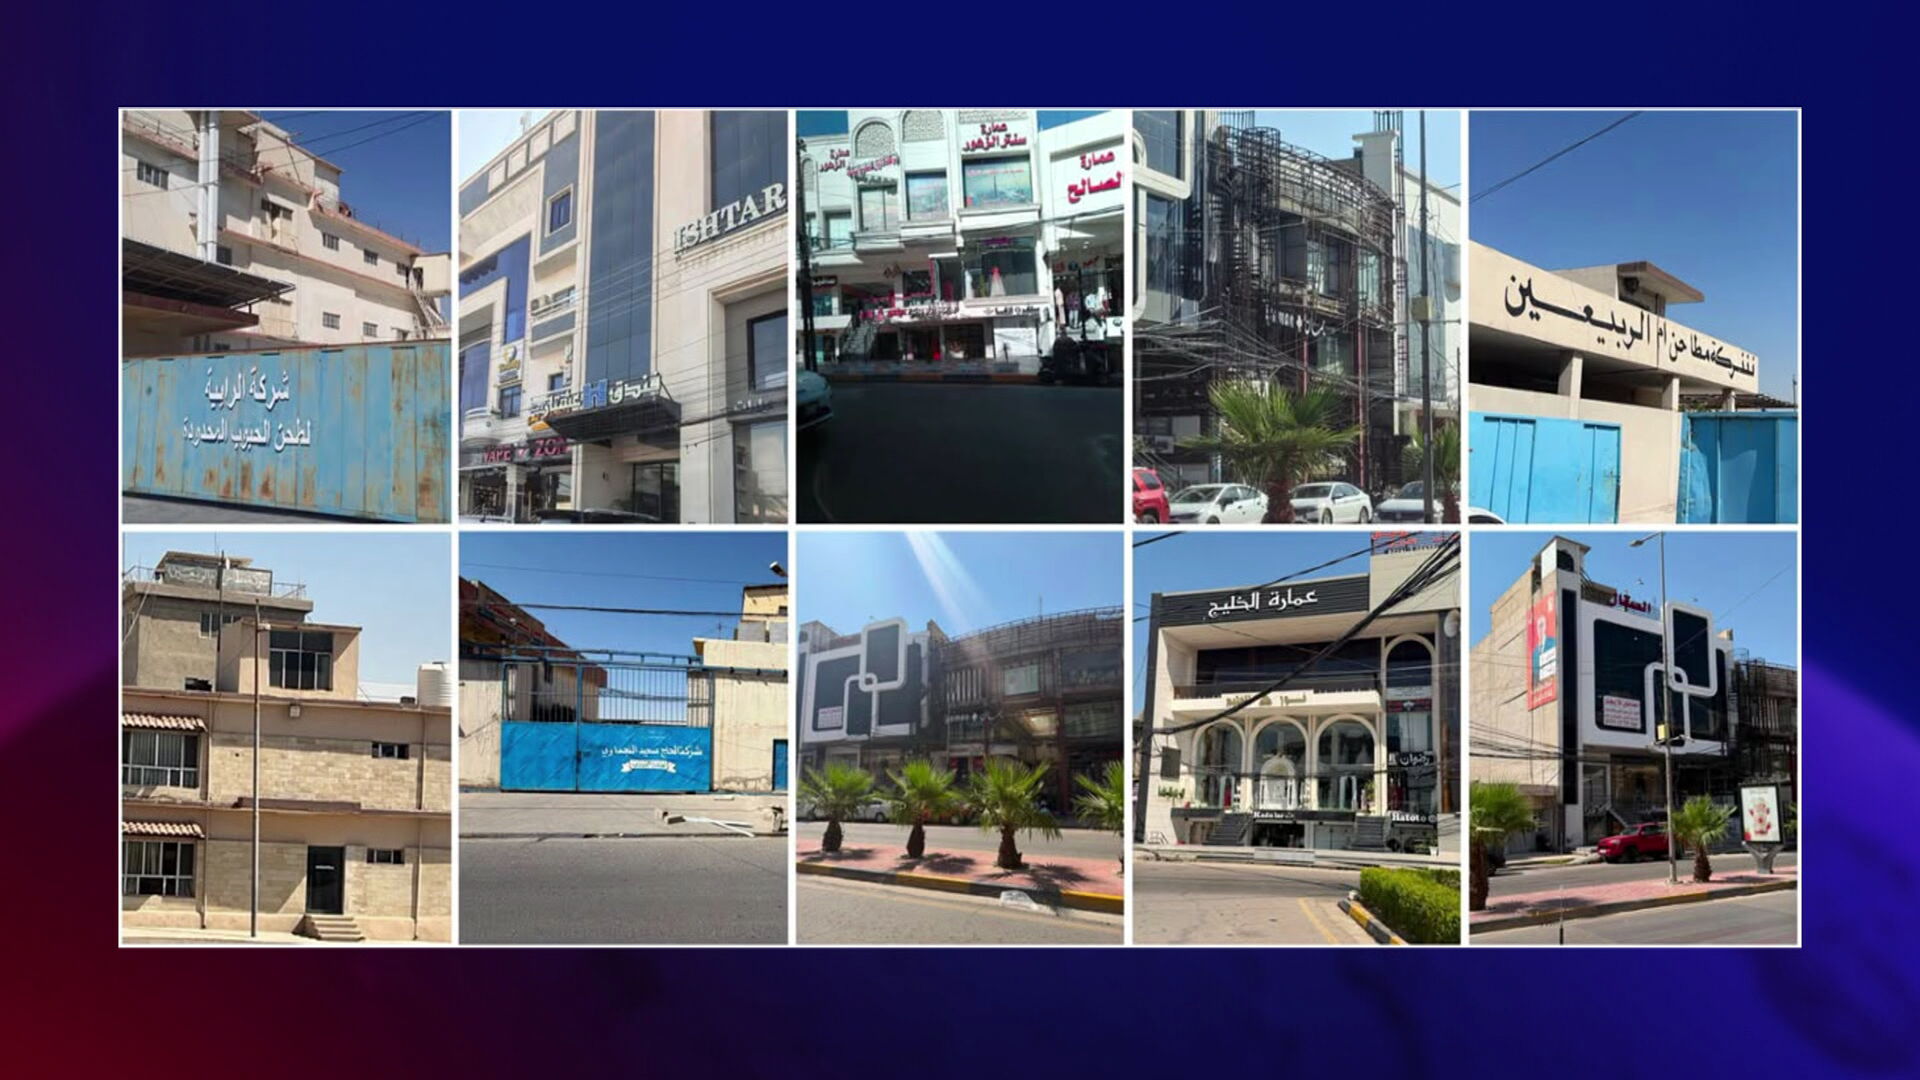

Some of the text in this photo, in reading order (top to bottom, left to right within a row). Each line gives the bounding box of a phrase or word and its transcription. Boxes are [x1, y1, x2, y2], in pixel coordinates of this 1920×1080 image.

[962, 135, 1000, 152] الزهور
[980, 121, 1008, 136] عمارة
[1080, 150, 1115, 170] عمارة
[1067, 171, 1124, 204] لصالح
[674, 182, 787, 254] ISHTAR
[1504, 275, 1651, 350] الربيعين
[204, 366, 290, 412] شركة الرابية
[609, 373, 661, 404] فندق
[182, 416, 311, 452] لطحن الحبوب المحدودة
[1208, 588, 1318, 618] عمارة الخليج
